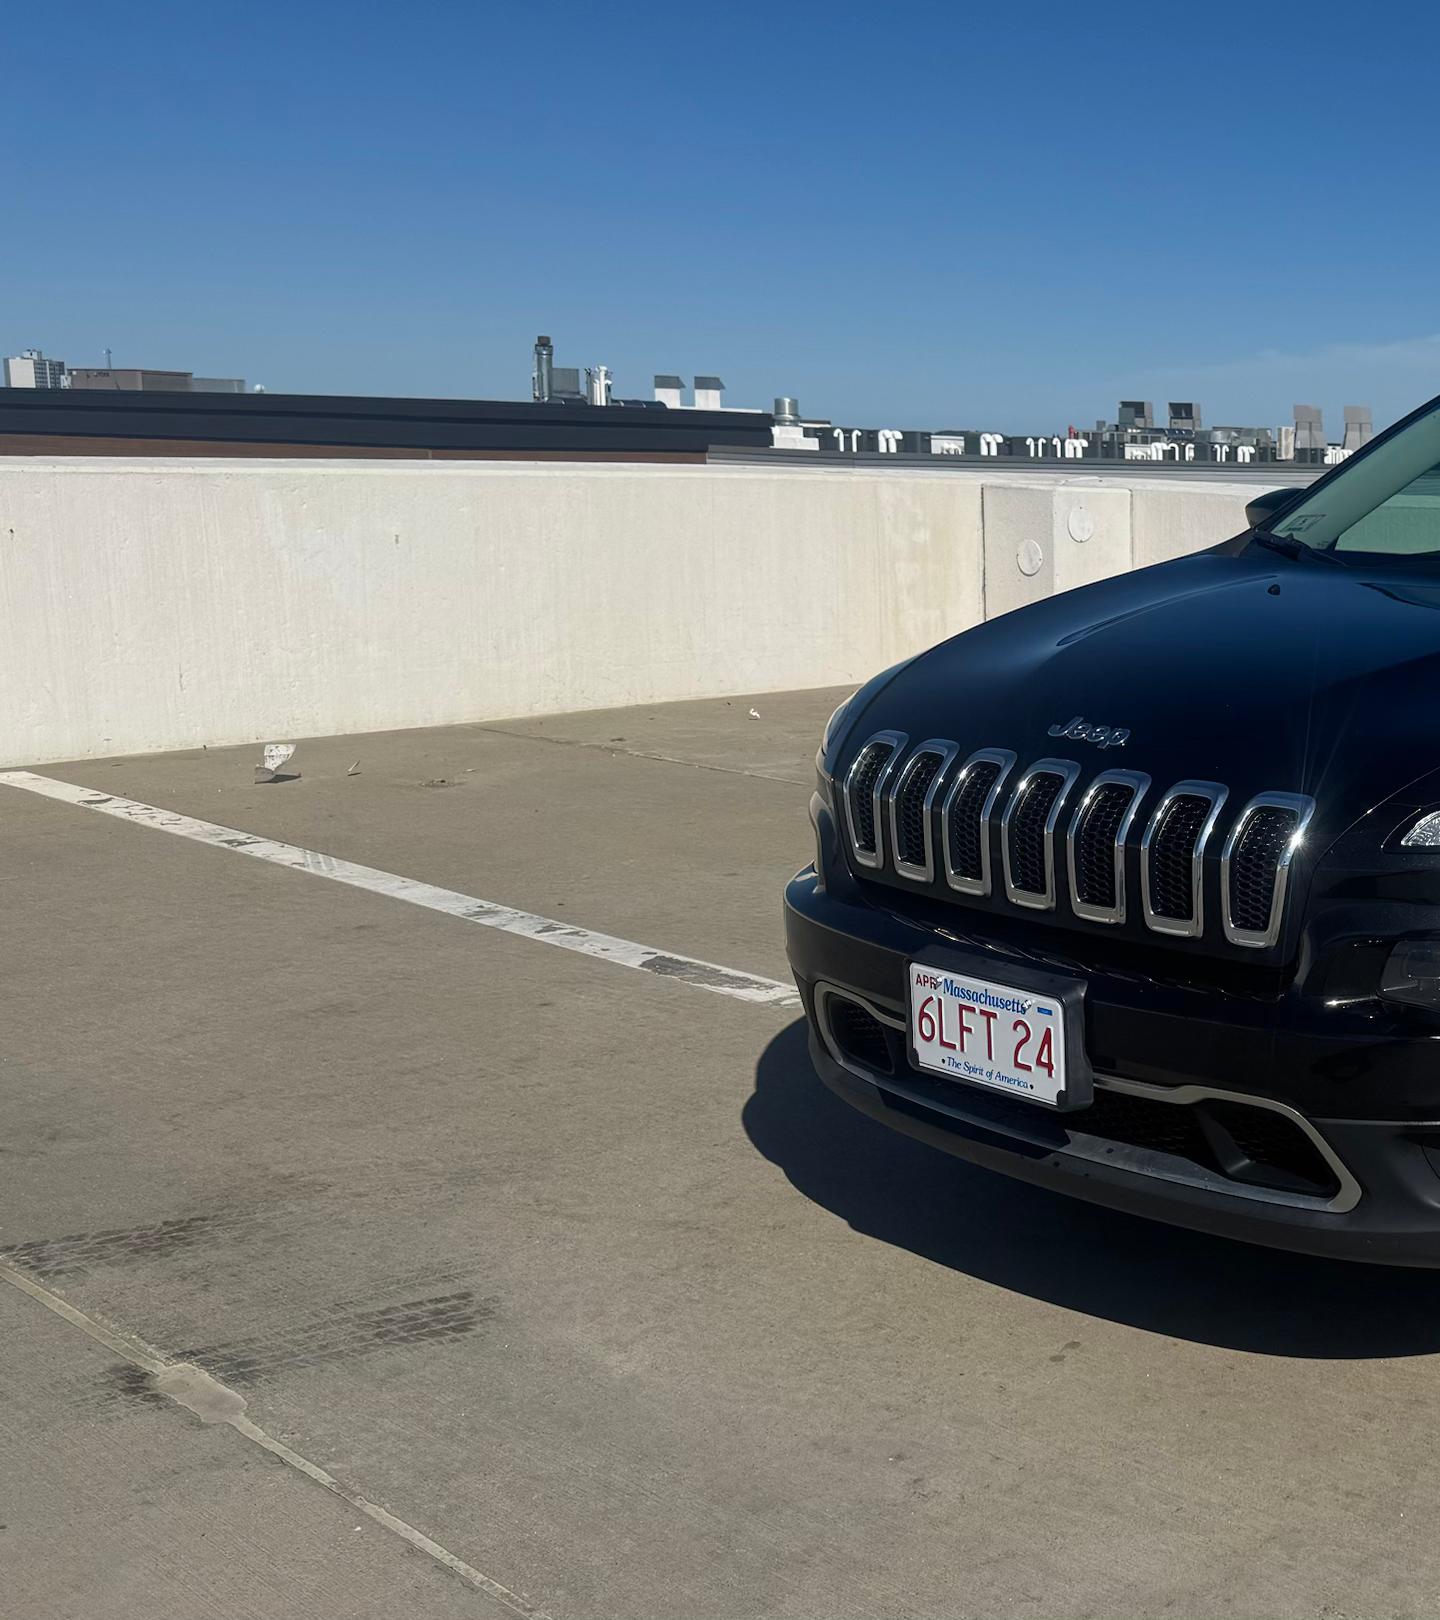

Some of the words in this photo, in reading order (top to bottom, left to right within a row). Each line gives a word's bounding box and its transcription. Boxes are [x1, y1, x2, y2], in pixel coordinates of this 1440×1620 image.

[1047, 716, 1131, 749] Jeep
[943, 979, 1030, 1015] Massachusetts
[918, 996, 999, 1061] 6LFT
[1013, 1020, 1055, 1078] 24
[947, 1057, 962, 1068] The
[963, 1061, 984, 1075] Spirit
[985, 1071, 994, 1081] of
[995, 1072, 1028, 1088] America
